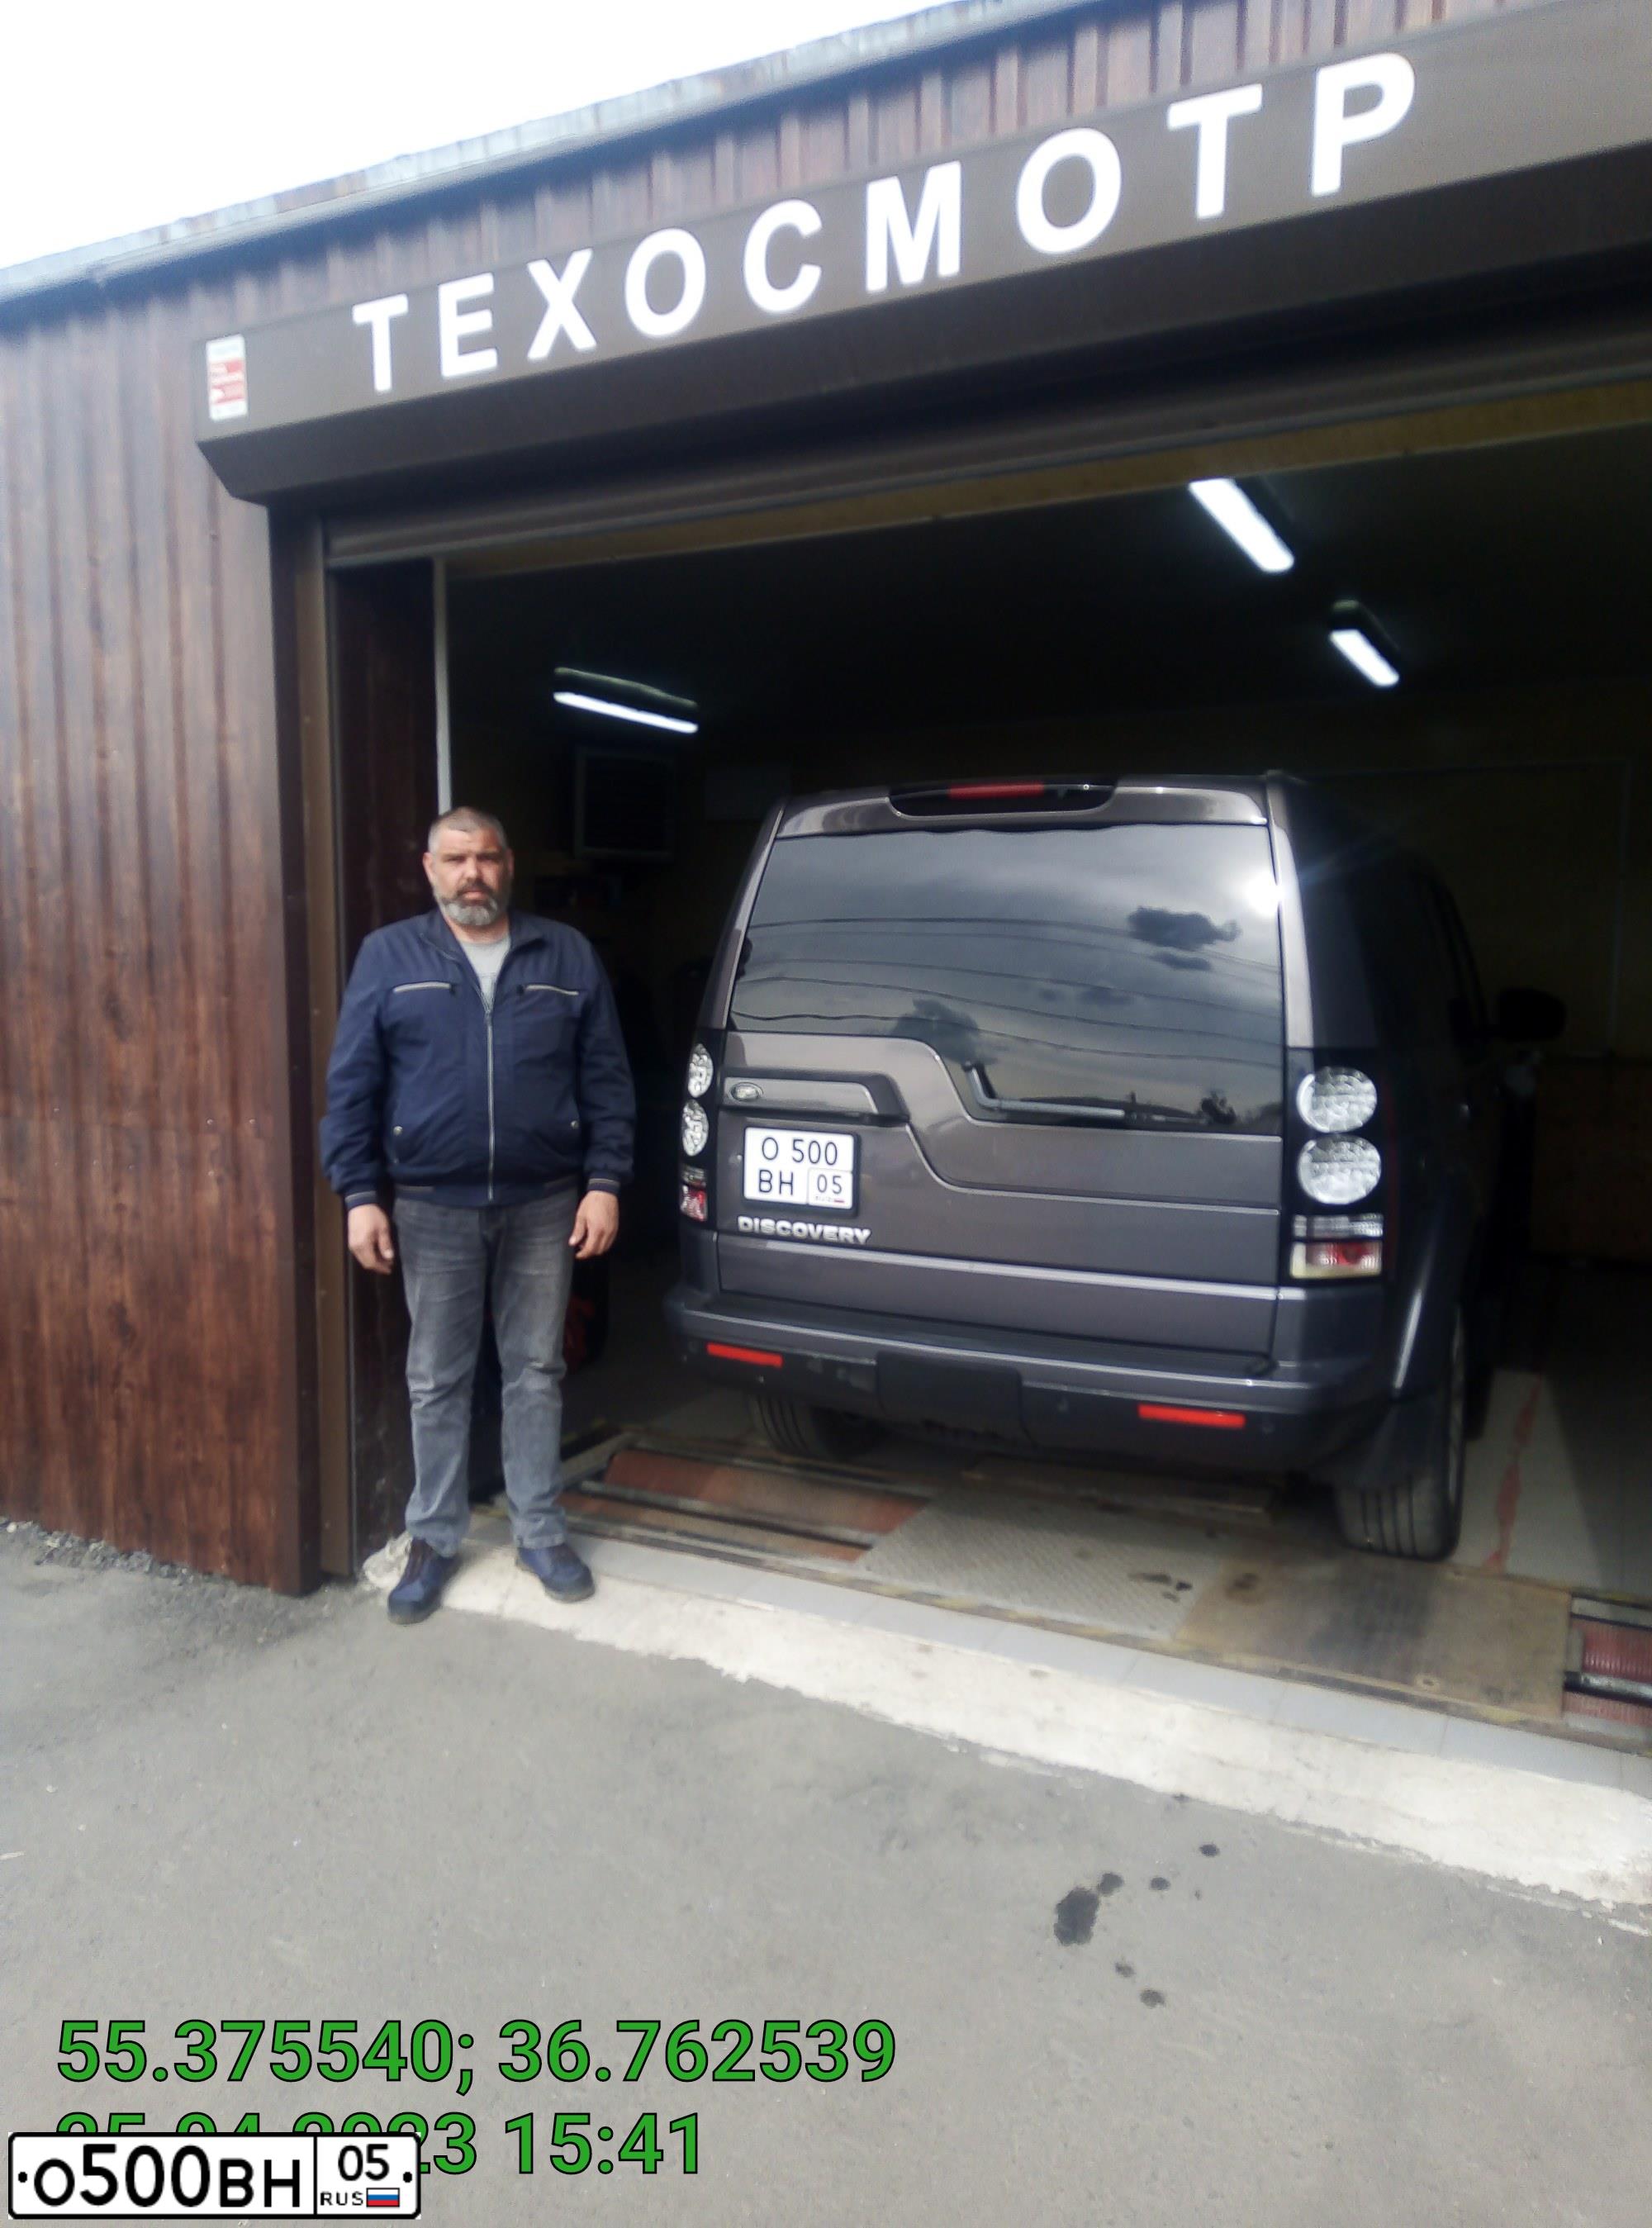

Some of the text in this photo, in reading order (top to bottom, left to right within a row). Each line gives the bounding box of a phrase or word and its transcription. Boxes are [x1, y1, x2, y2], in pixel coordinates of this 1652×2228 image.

[353, 52, 1416, 392] ТЕХОСМОТР
[762, 1137, 838, 1166] О 500
[758, 1169, 842, 1195] ВН 05
[737, 1215, 871, 1244] DISCOVERY
